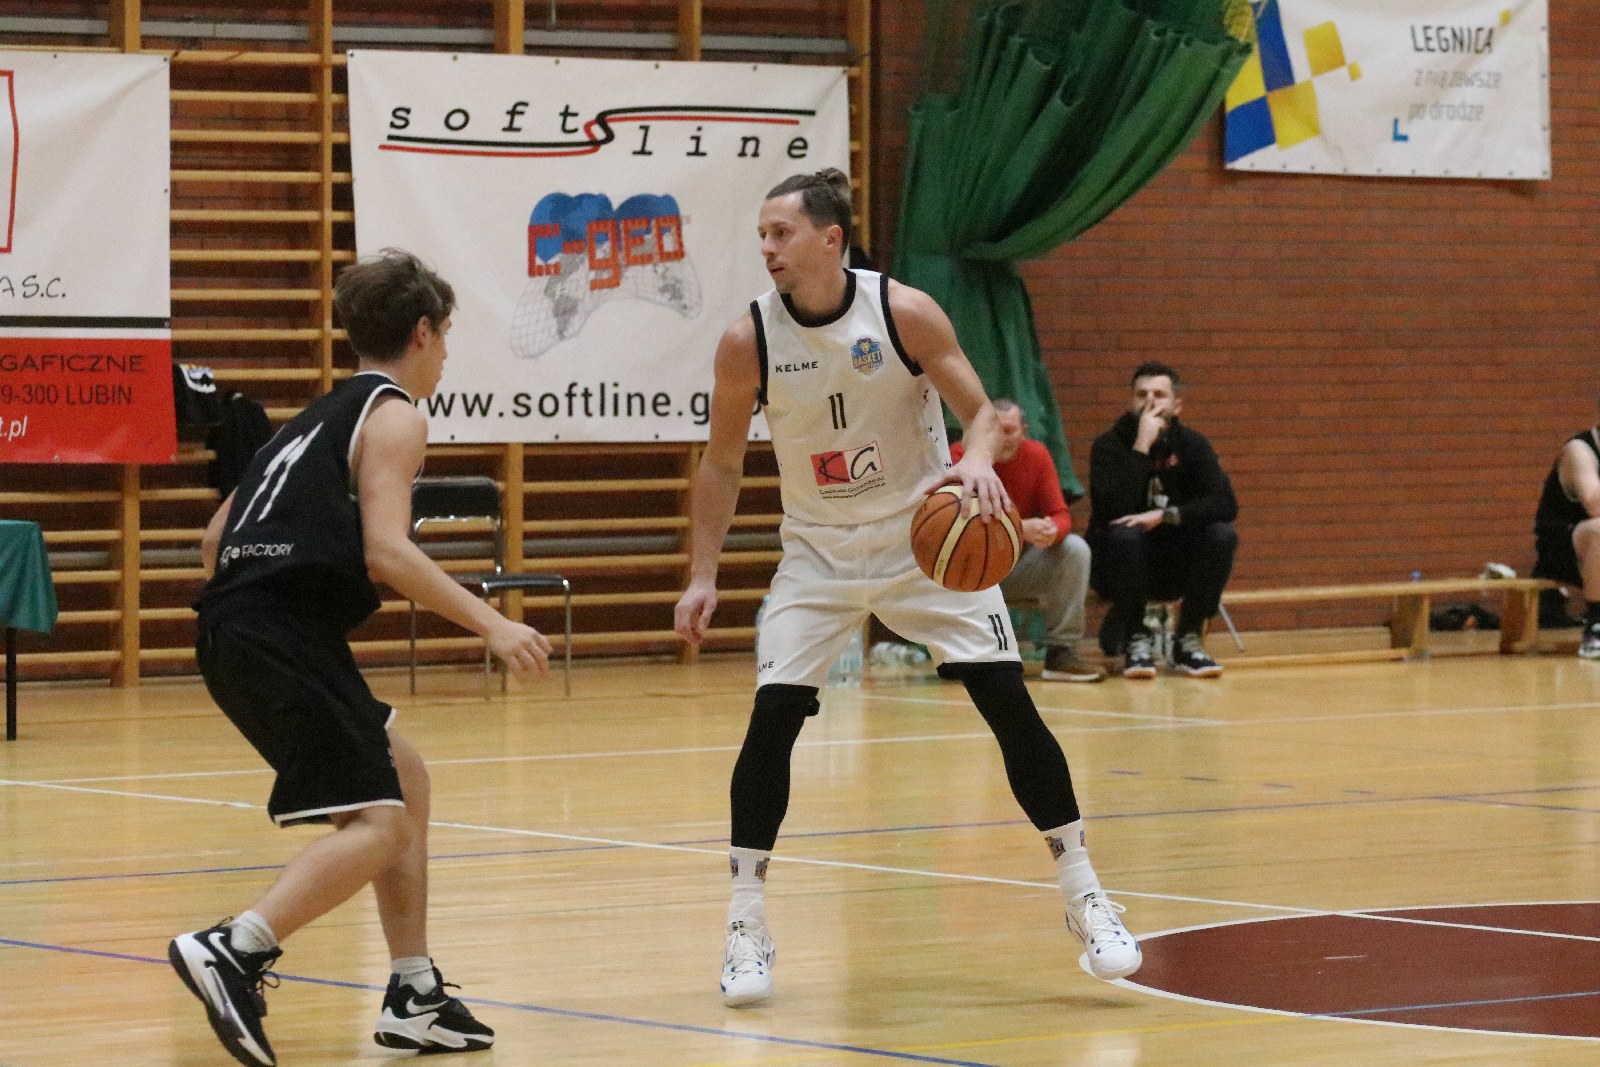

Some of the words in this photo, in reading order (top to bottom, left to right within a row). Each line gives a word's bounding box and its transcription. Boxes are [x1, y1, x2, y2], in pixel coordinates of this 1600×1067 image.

[1410, 24, 1496, 54] LEGNICA
[0, 353, 146, 373] GAFICZNE
[775, 360, 819, 374] KELME
[1, 383, 60, 405] 9-300
[65, 384, 133, 406] LUBIN
[827, 391, 848, 431] 11
[232, 421, 325, 534] 11
[241, 543, 295, 559] FACTORY
[987, 613, 1009, 651] 11
